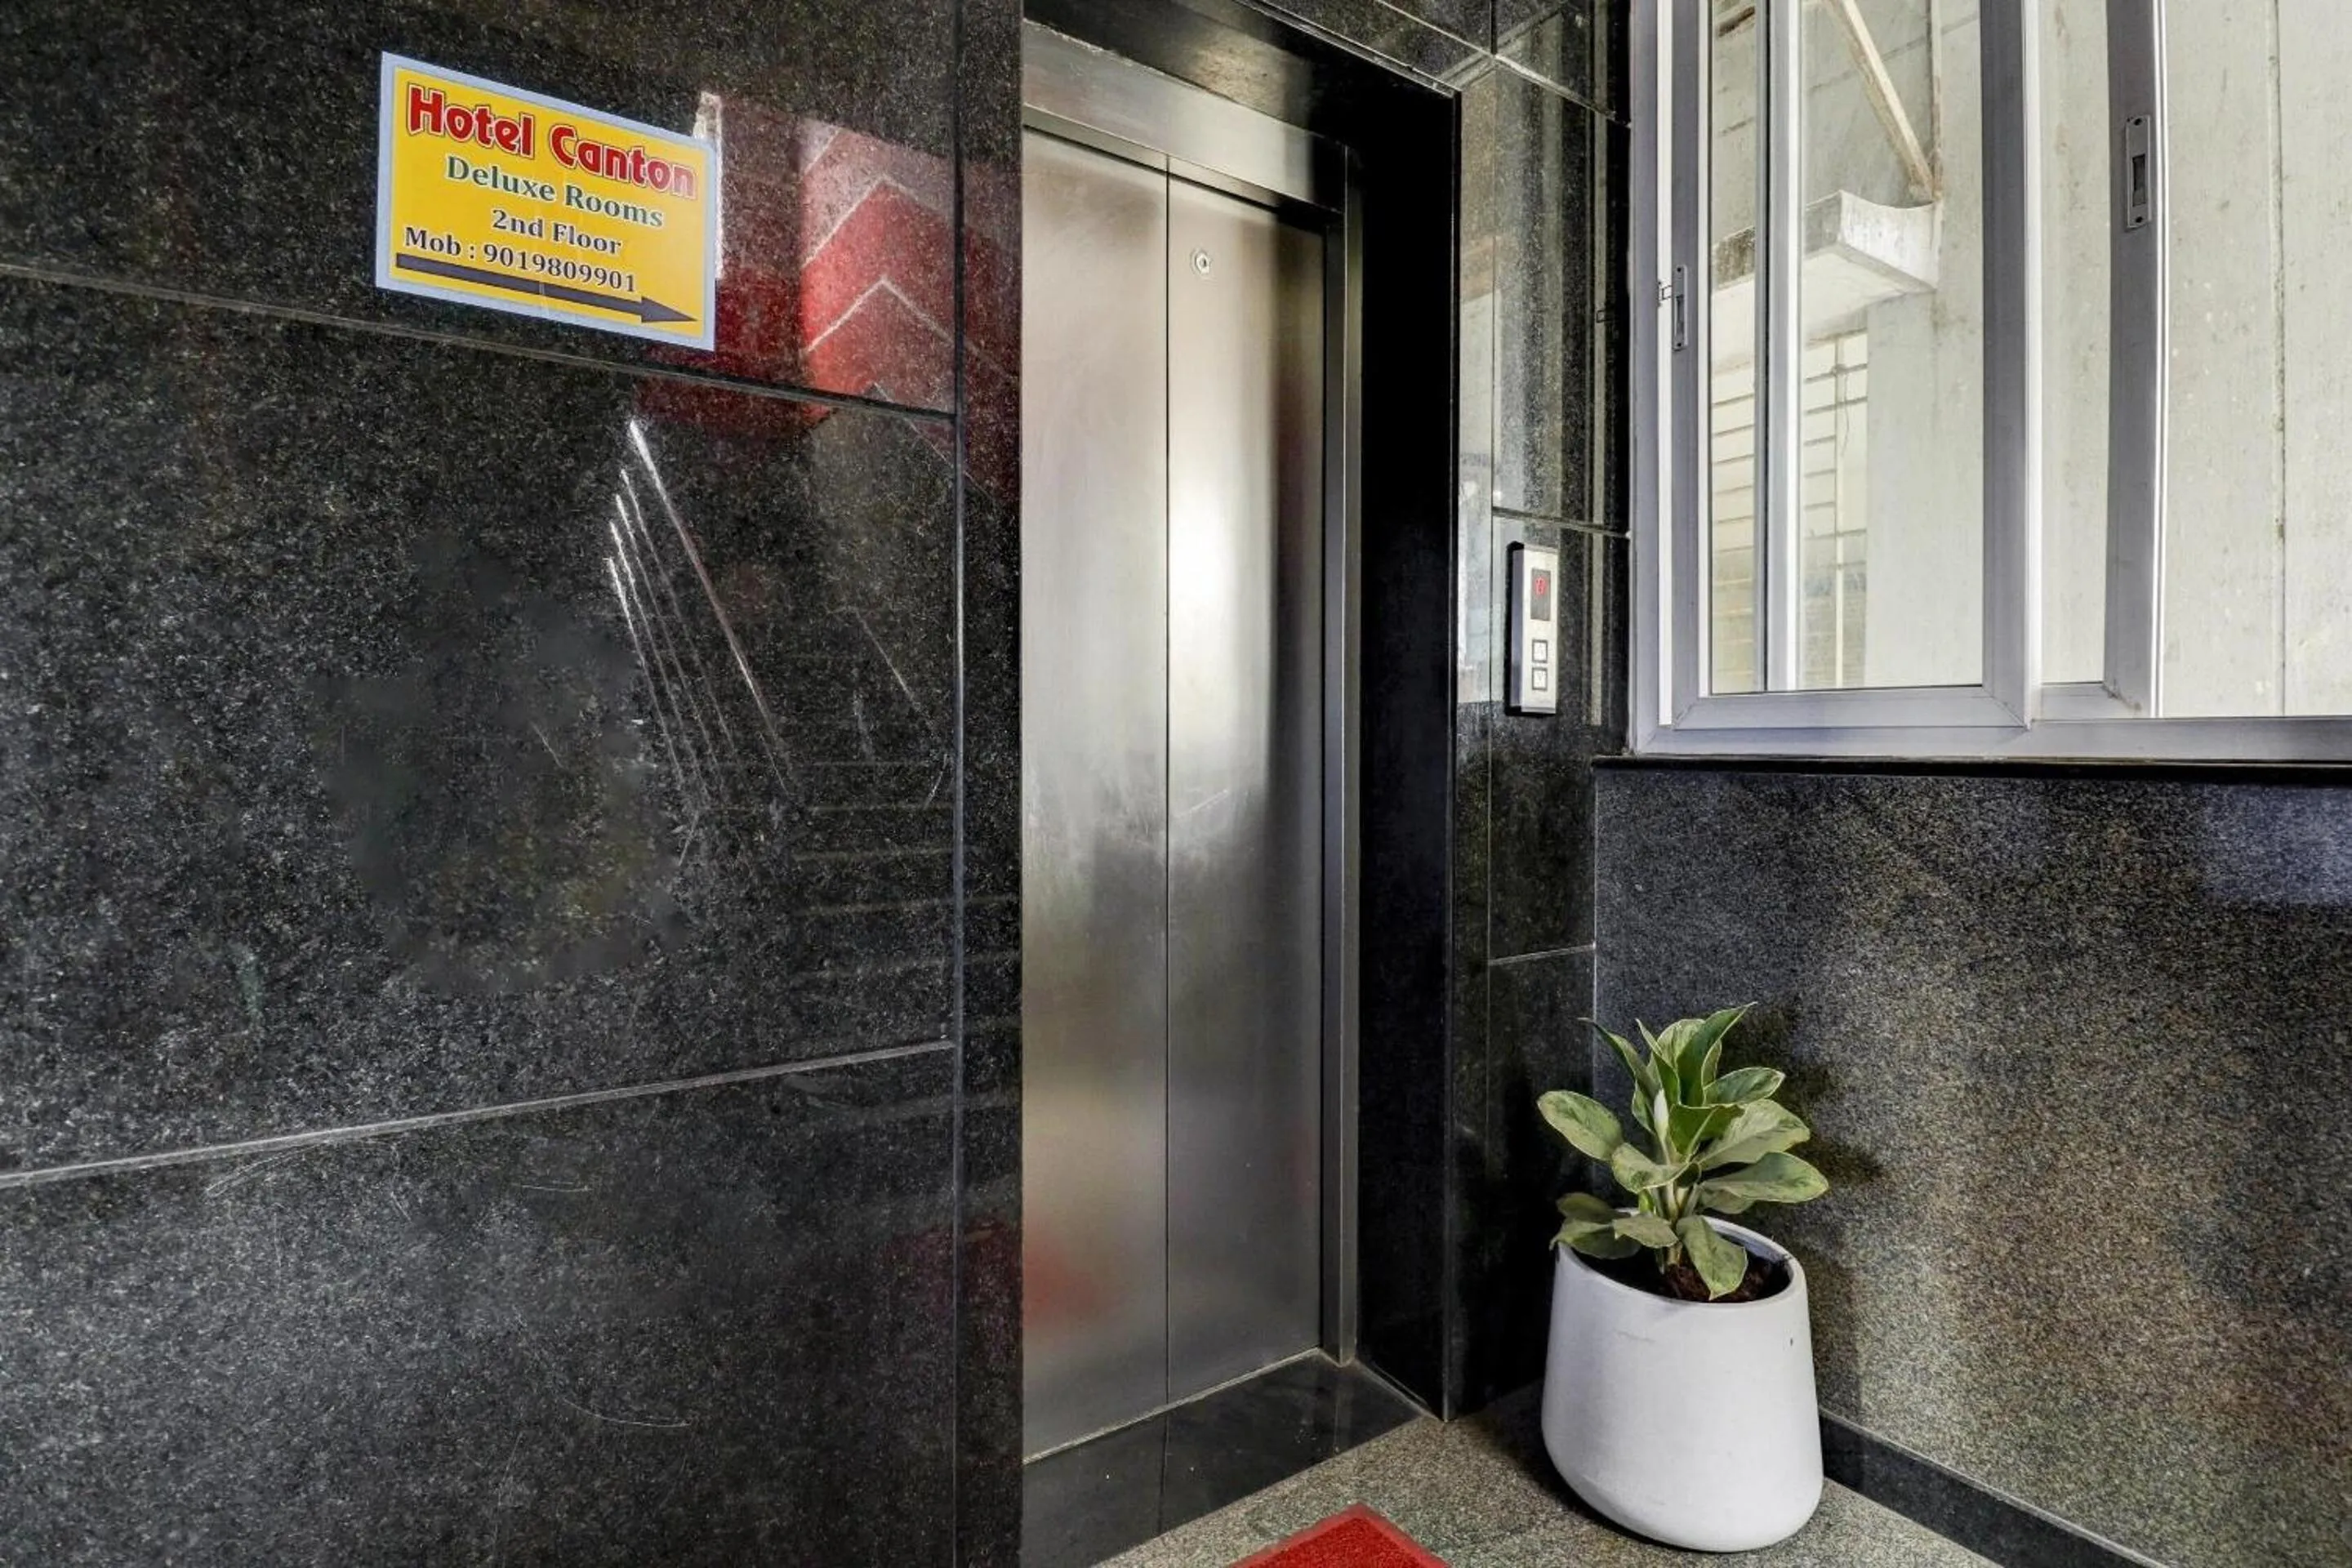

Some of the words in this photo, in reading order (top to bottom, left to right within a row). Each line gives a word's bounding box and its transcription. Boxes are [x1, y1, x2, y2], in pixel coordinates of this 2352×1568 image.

[408, 83, 535, 159] Hotel
[549, 124, 697, 198] Canton
[447, 155, 555, 202] Deluxe
[564, 185, 663, 228] Rooms
[492, 209, 544, 238] 2nd
[552, 222, 621, 255] Floor
[483, 244, 636, 292] 9019809901
